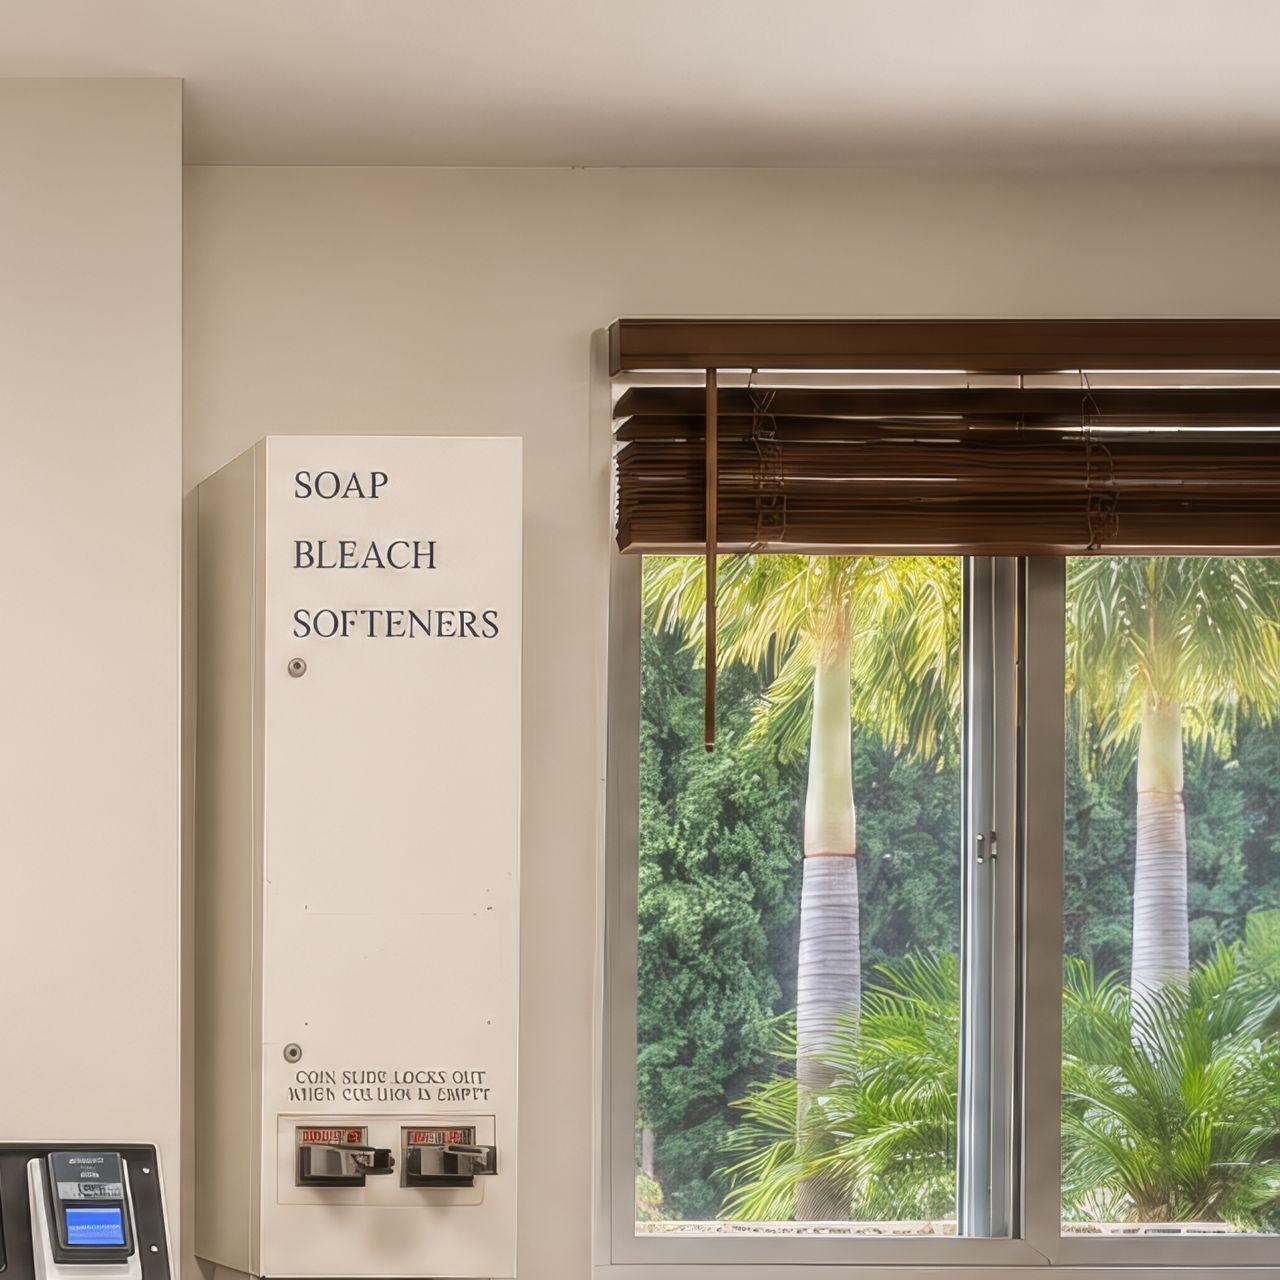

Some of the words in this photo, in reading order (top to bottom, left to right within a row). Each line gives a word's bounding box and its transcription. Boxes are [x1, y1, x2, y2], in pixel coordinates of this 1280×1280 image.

[294, 470, 389, 499] SOAP
[292, 540, 438, 570] BLEACH
[292, 608, 500, 639] SOFTENERS
[296, 1070, 336, 1085] COIN
